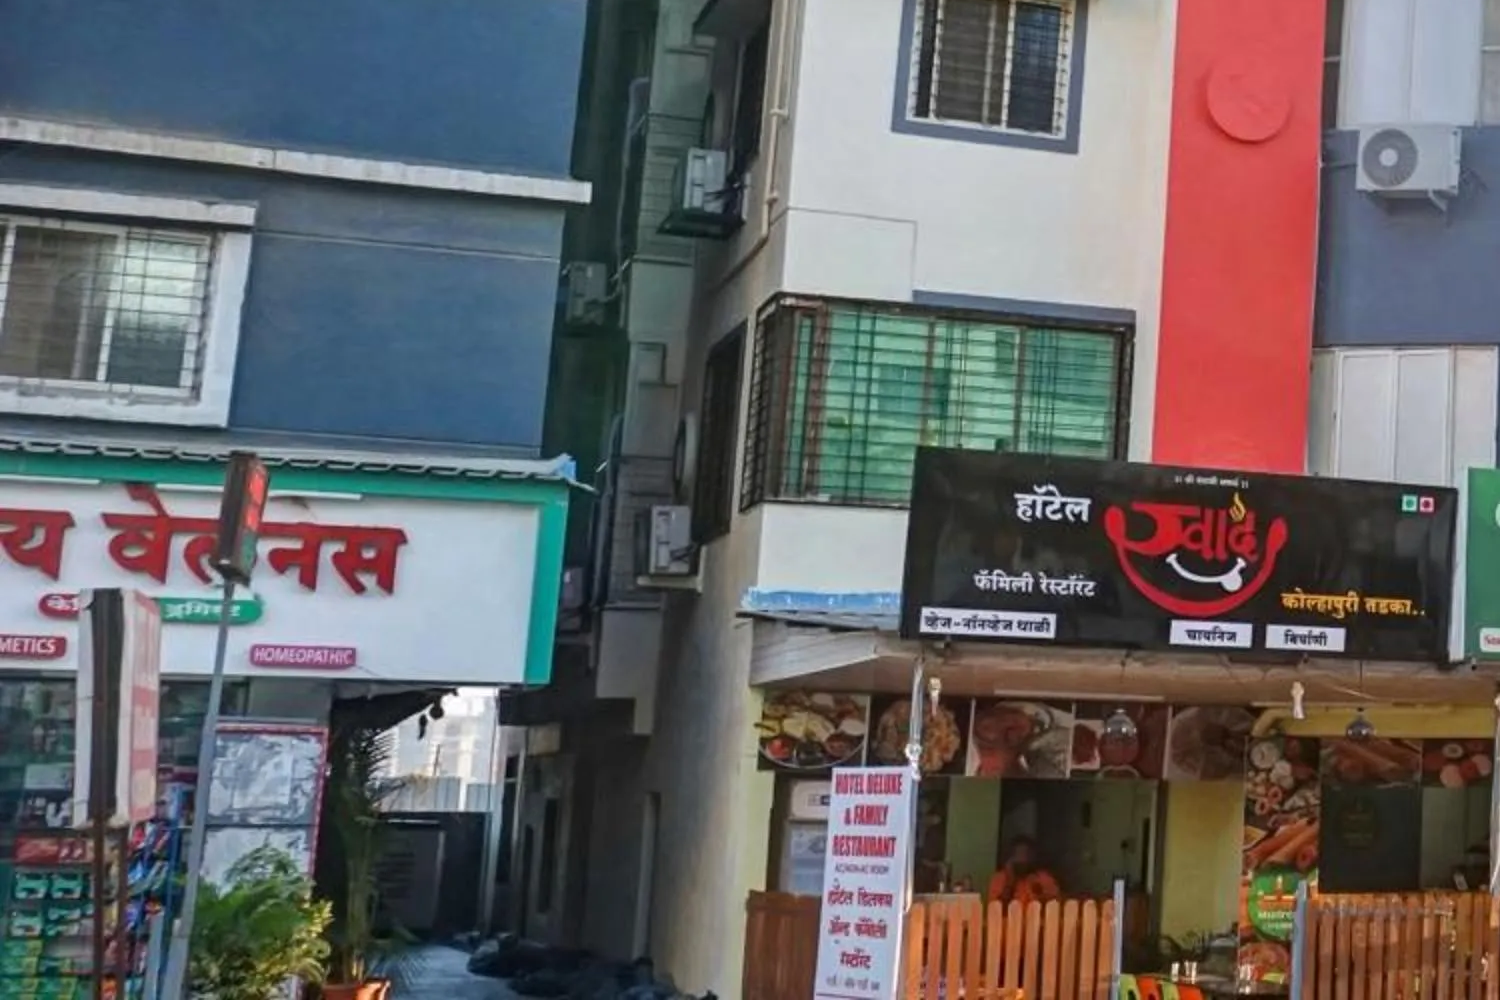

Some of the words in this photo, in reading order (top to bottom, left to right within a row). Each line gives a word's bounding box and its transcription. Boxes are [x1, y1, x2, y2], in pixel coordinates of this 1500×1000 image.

[1014, 485, 1091, 522] हॉटेल
[973, 569, 1035, 593] फॅमिली
[1280, 587, 1359, 619] कोल्हापुरी
[253, 646, 353, 665] HOMEOPATHIC
